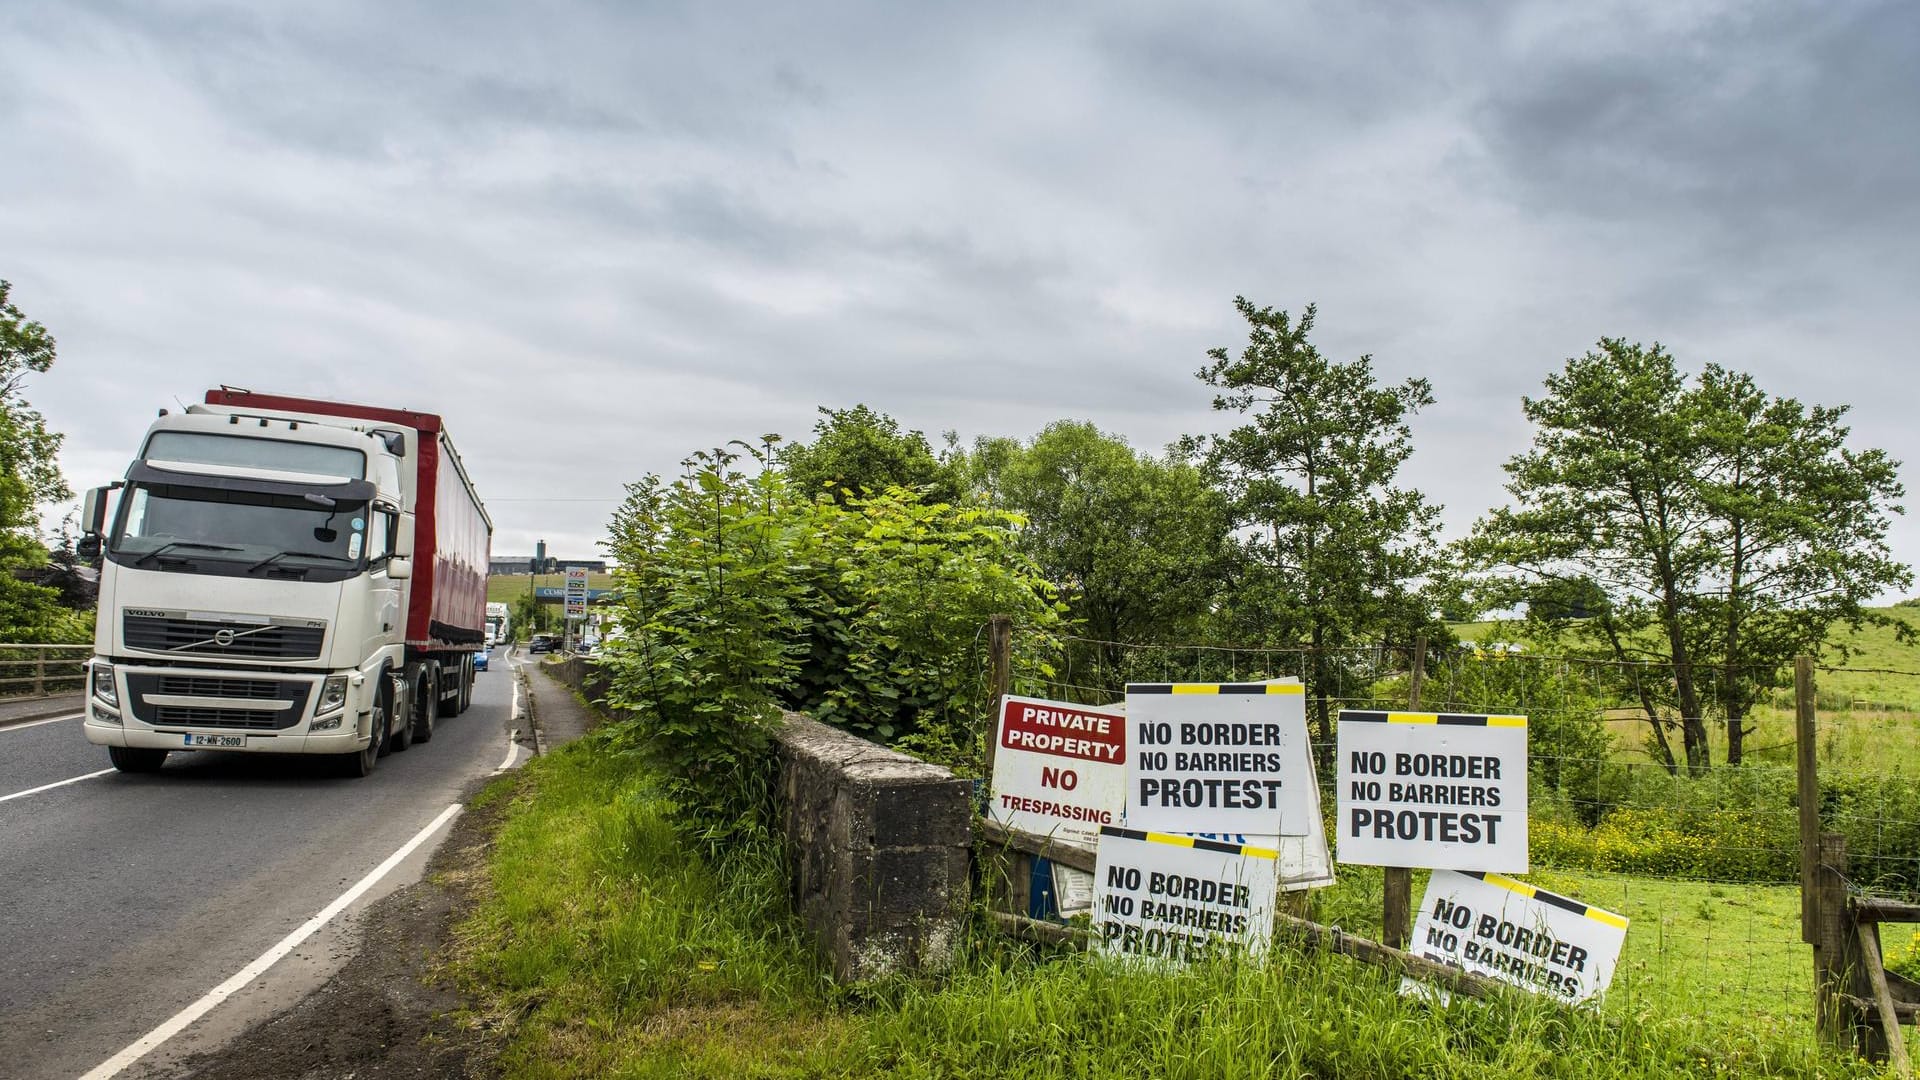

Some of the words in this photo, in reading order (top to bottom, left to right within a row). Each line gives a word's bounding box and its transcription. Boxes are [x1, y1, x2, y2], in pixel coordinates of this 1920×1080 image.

[127, 609, 165, 618] VOLVO
[1022, 707, 1111, 734] PRIVATE
[1139, 723, 1172, 745] NO
[1181, 723, 1280, 746] BORDER
[1008, 729, 1120, 759] PROPERTY
[1139, 752, 1168, 771] NO
[1175, 752, 1281, 772] BARRIERS
[1352, 751, 1386, 775] NO
[1395, 753, 1501, 780] BORDER
[1041, 766, 1078, 791] NO
[1140, 779, 1282, 809] PROTEST
[1352, 781, 1381, 801] NO
[1389, 783, 1501, 807] BARRIERS
[1001, 795, 1112, 824] TRESPASSING
[1352, 808, 1502, 845] PROTEST
[1107, 865, 1141, 891] NO
[1150, 872, 1250, 909] BORDER
[1105, 895, 1134, 916] NO
[1140, 900, 1247, 933] BARRIERS
[1432, 898, 1471, 930] NO
[1477, 913, 1588, 973] BORDER
[1426, 927, 1458, 953] NO
[1463, 940, 1579, 998] BARRIERS
